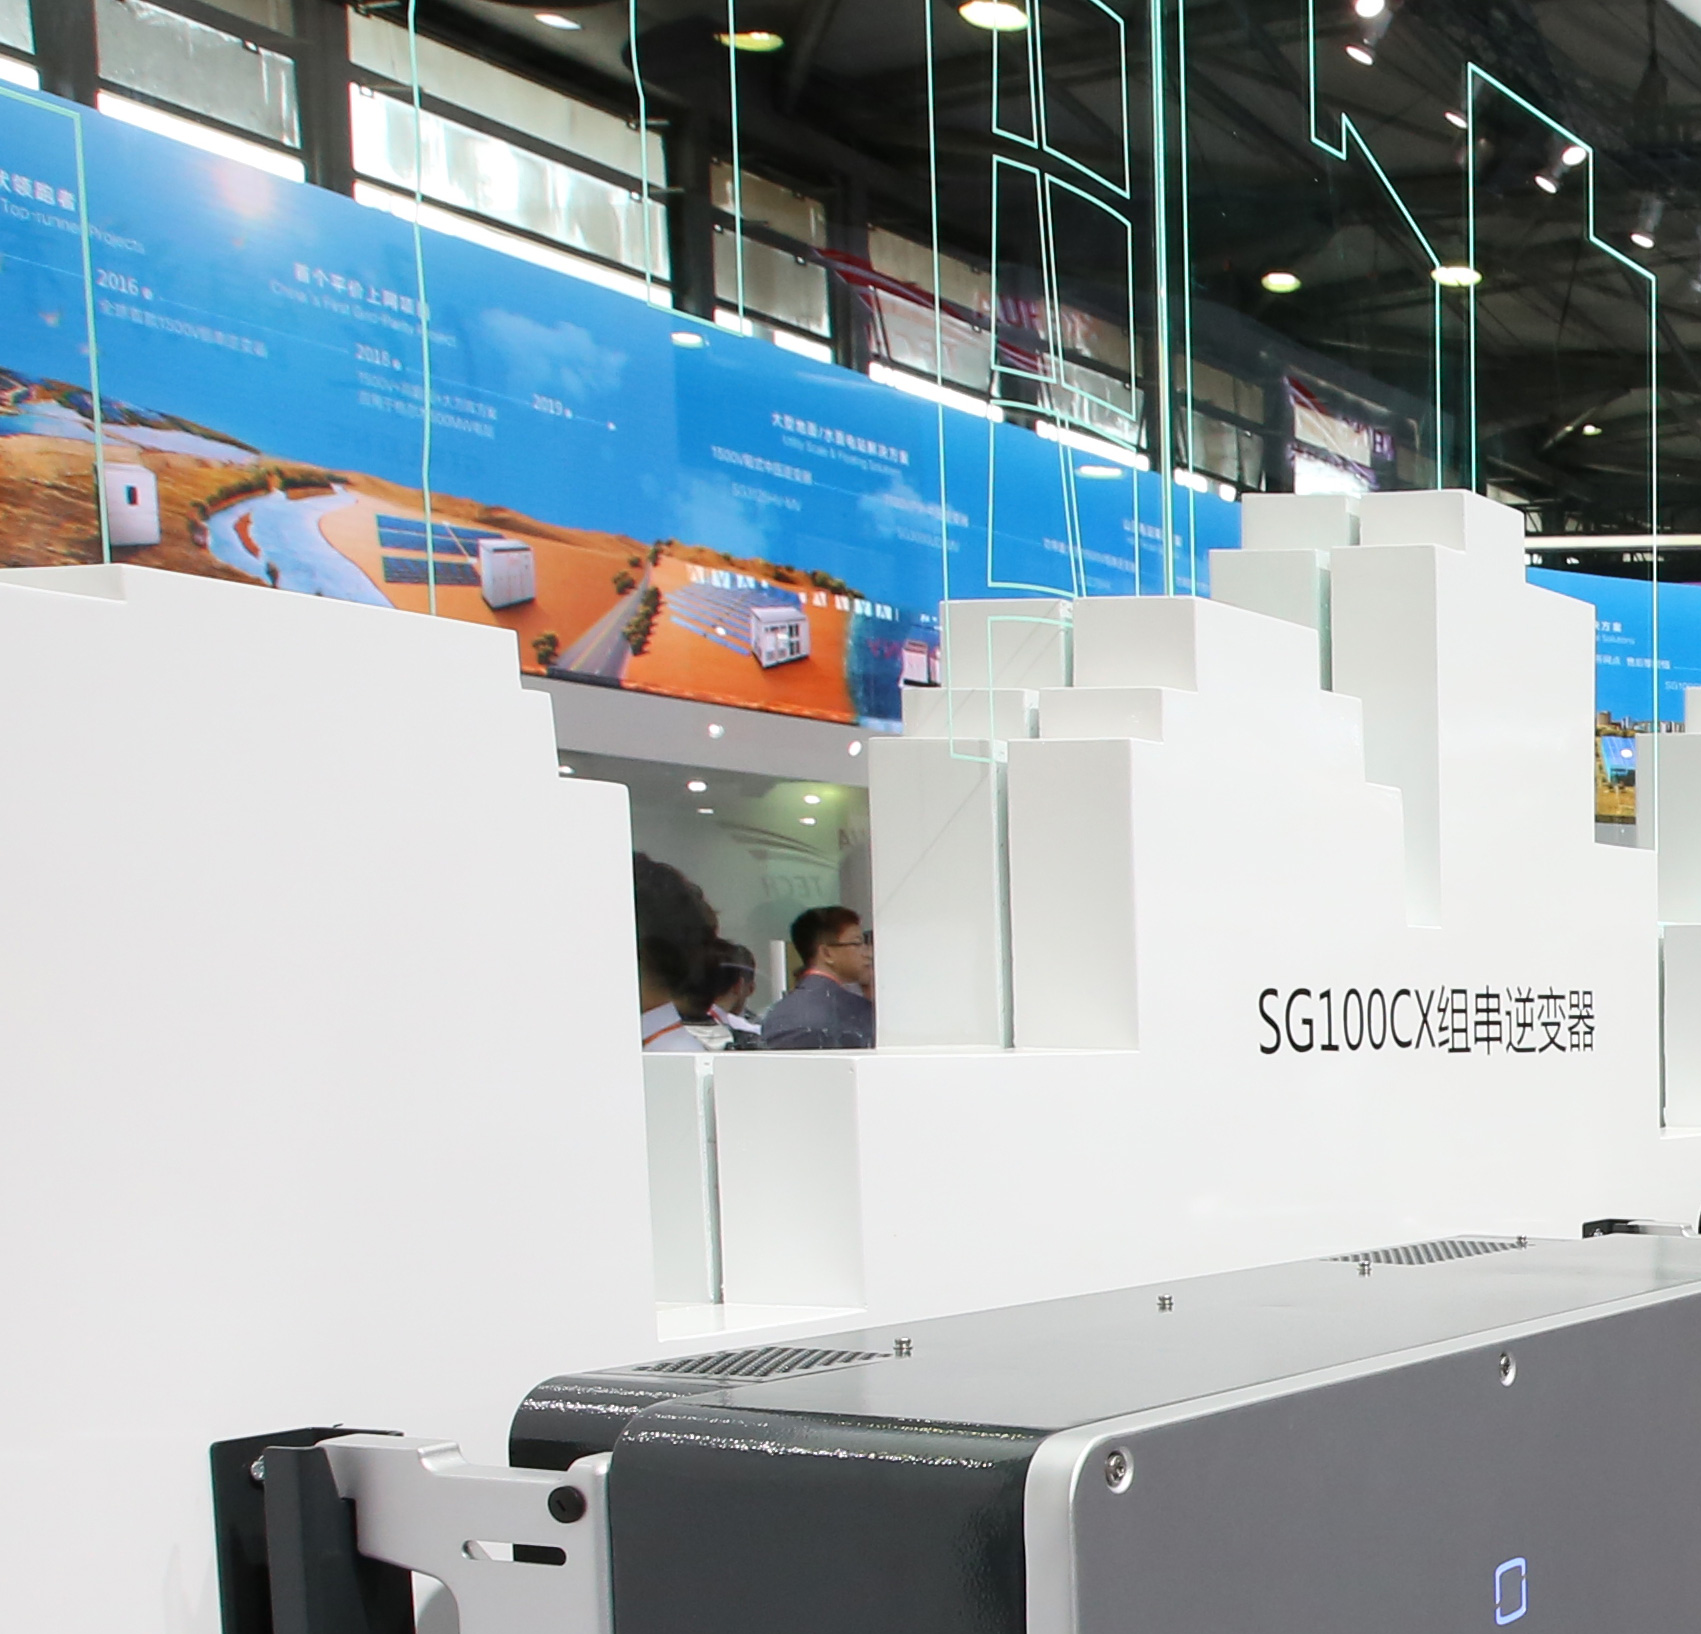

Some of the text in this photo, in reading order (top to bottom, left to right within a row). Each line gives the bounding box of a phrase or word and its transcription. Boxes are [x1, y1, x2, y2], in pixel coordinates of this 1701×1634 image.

[97, 267, 138, 295] 2016
[532, 394, 562, 416] 2019
[1258, 985, 1596, 1055] SG100CX组串逆变器
